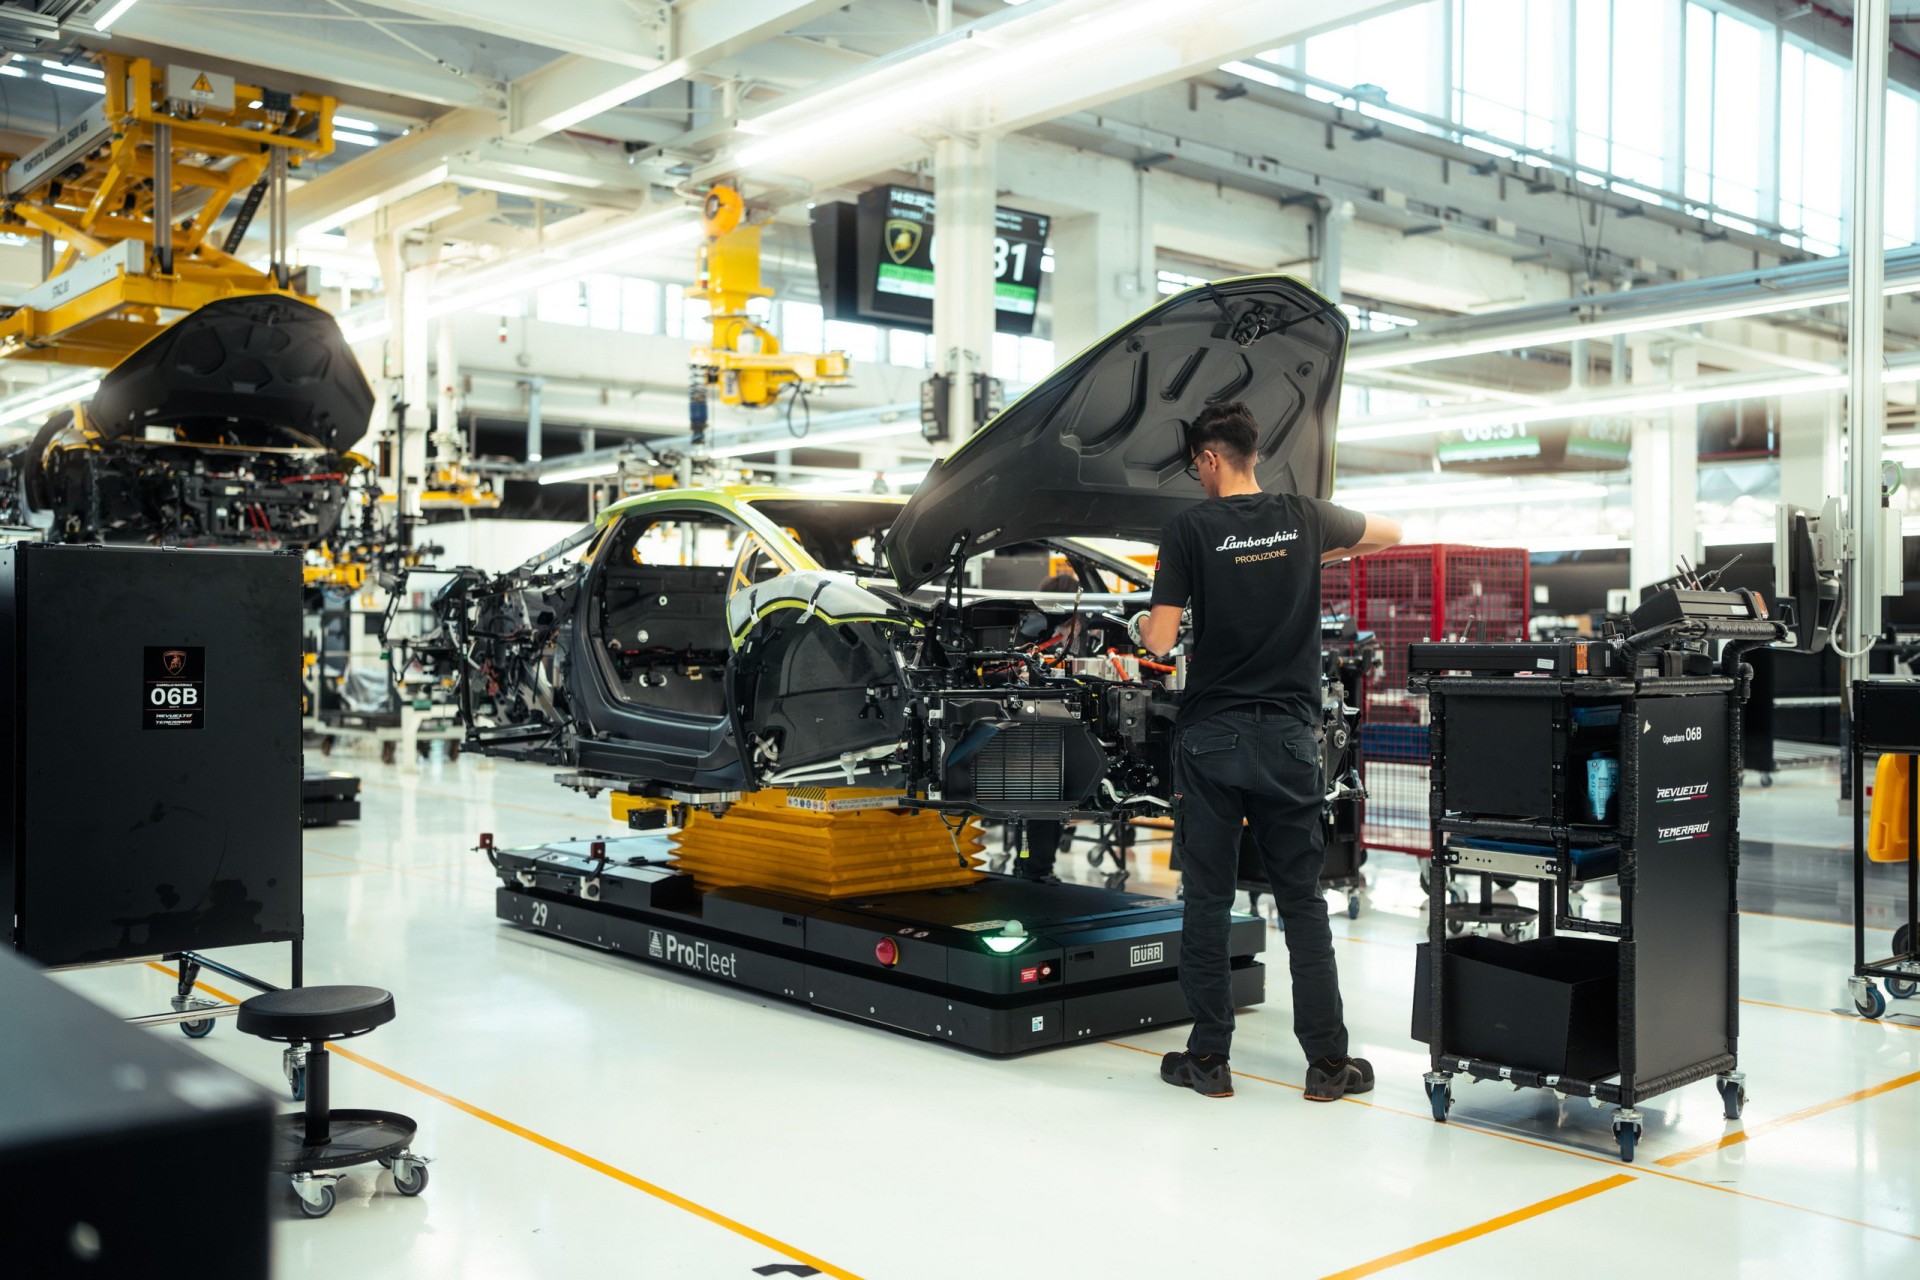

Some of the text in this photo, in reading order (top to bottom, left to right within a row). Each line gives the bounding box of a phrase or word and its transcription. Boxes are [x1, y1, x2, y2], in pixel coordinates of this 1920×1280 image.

[1216, 529, 1299, 552] Lamborghini
[1235, 549, 1288, 564] PRODUZIONE
[150, 687, 198, 706] 06B
[1662, 726, 1702, 745] Operatore 06B
[1656, 782, 1709, 799] REVUELTO
[1658, 821, 1710, 839] TEMERARIO
[532, 901, 548, 927] 29
[666, 934, 737, 978] ProFleet
[1133, 944, 1161, 964] DÜRR
